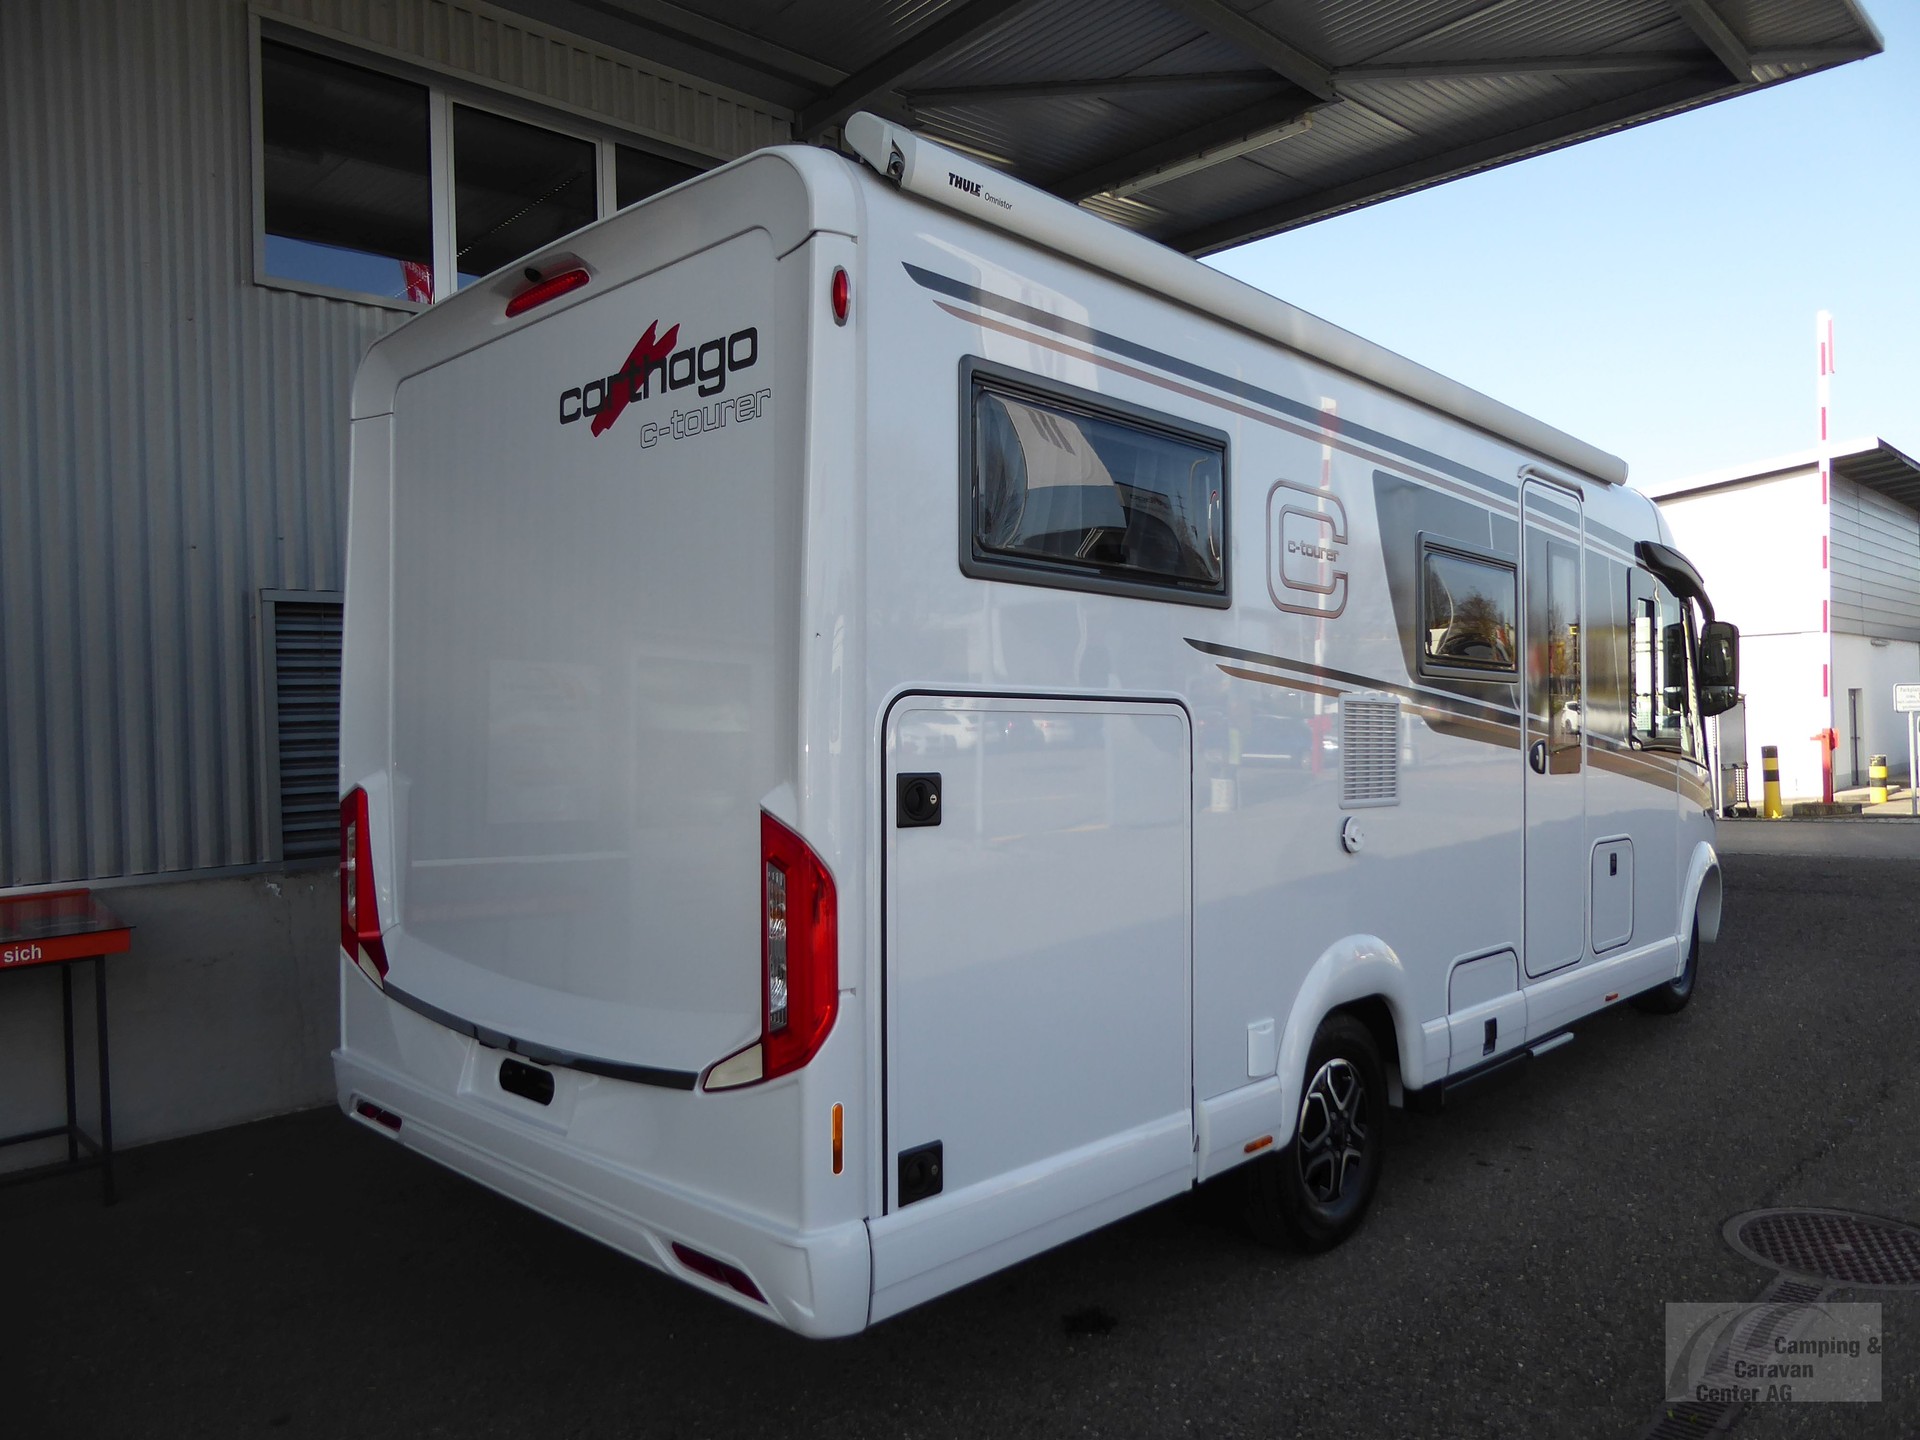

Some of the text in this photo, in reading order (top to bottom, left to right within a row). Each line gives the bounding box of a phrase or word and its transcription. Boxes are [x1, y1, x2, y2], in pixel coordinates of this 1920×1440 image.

[948, 172, 1013, 210] THULE Omnistor
[559, 326, 758, 425] carthago
[640, 388, 771, 449] c-tourer
[1287, 540, 1340, 562] c-tourer
[4, 944, 42, 963] sich
